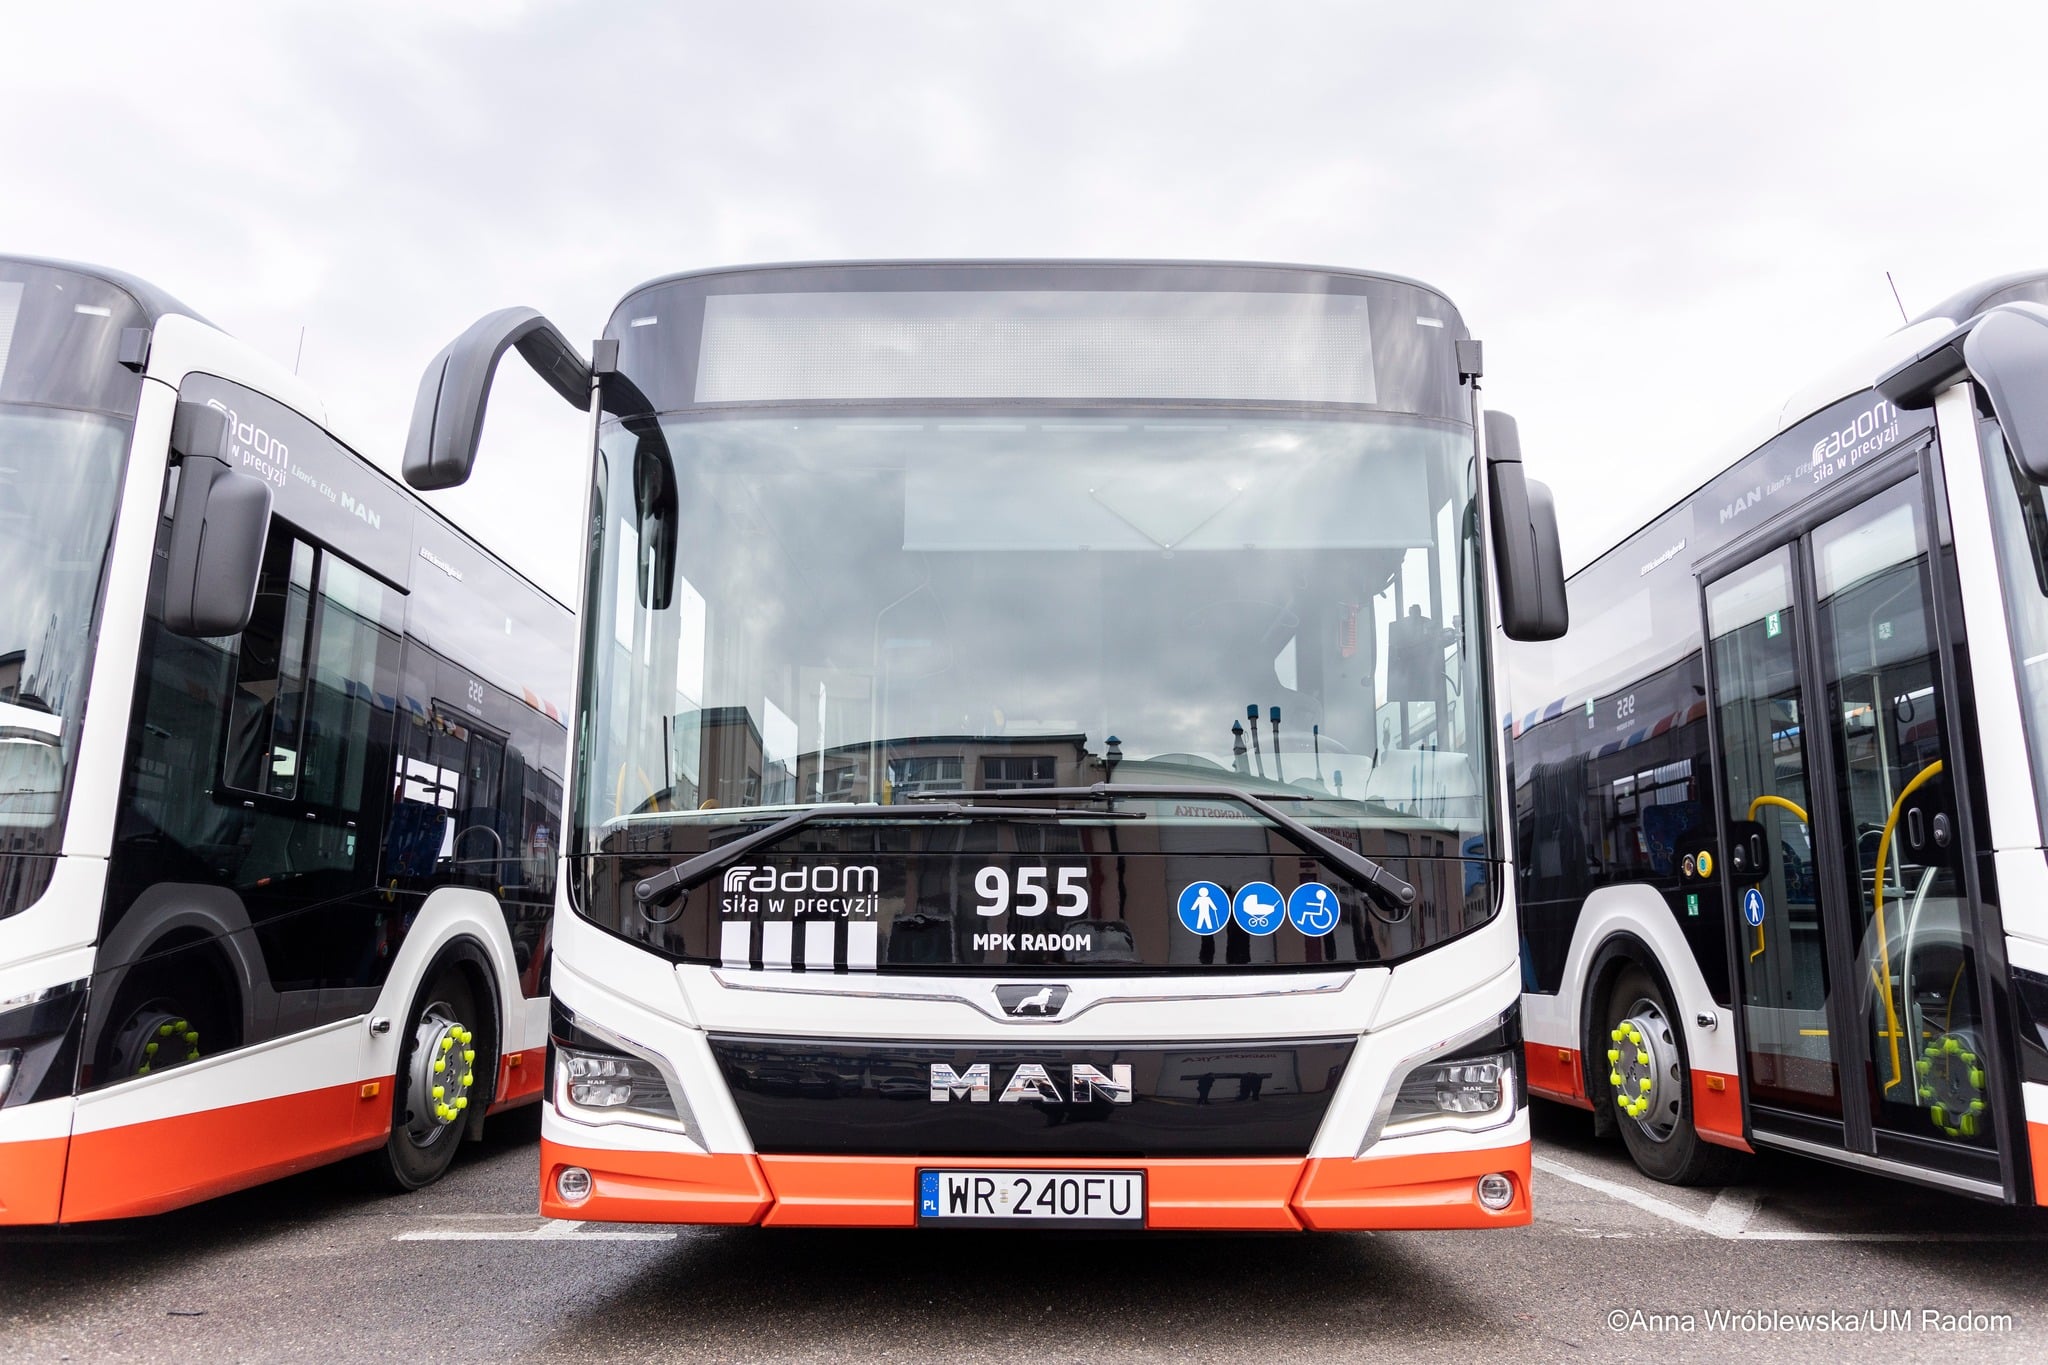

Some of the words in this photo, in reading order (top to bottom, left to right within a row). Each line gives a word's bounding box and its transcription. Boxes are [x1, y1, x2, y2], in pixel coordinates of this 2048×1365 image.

[242, 450, 287, 488] precyzji
[1813, 463, 1834, 484] siła
[1836, 454, 1847, 470] w
[1850, 419, 1899, 466] precyzji
[341, 490, 381, 531] MAN
[1719, 485, 1762, 525] MAN
[723, 865, 879, 893] radom
[974, 866, 1089, 917] 955
[722, 895, 759, 913] siła
[768, 898, 785, 913] w
[794, 894, 879, 917] precyzji
[973, 933, 1016, 951] MPK
[1021, 933, 1091, 951] RADOM
[930, 1063, 1133, 1103] MAN
[923, 1200, 937, 1211] PL
[948, 1177, 996, 1214] WR
[1012, 1178, 1132, 1216] 240FU
